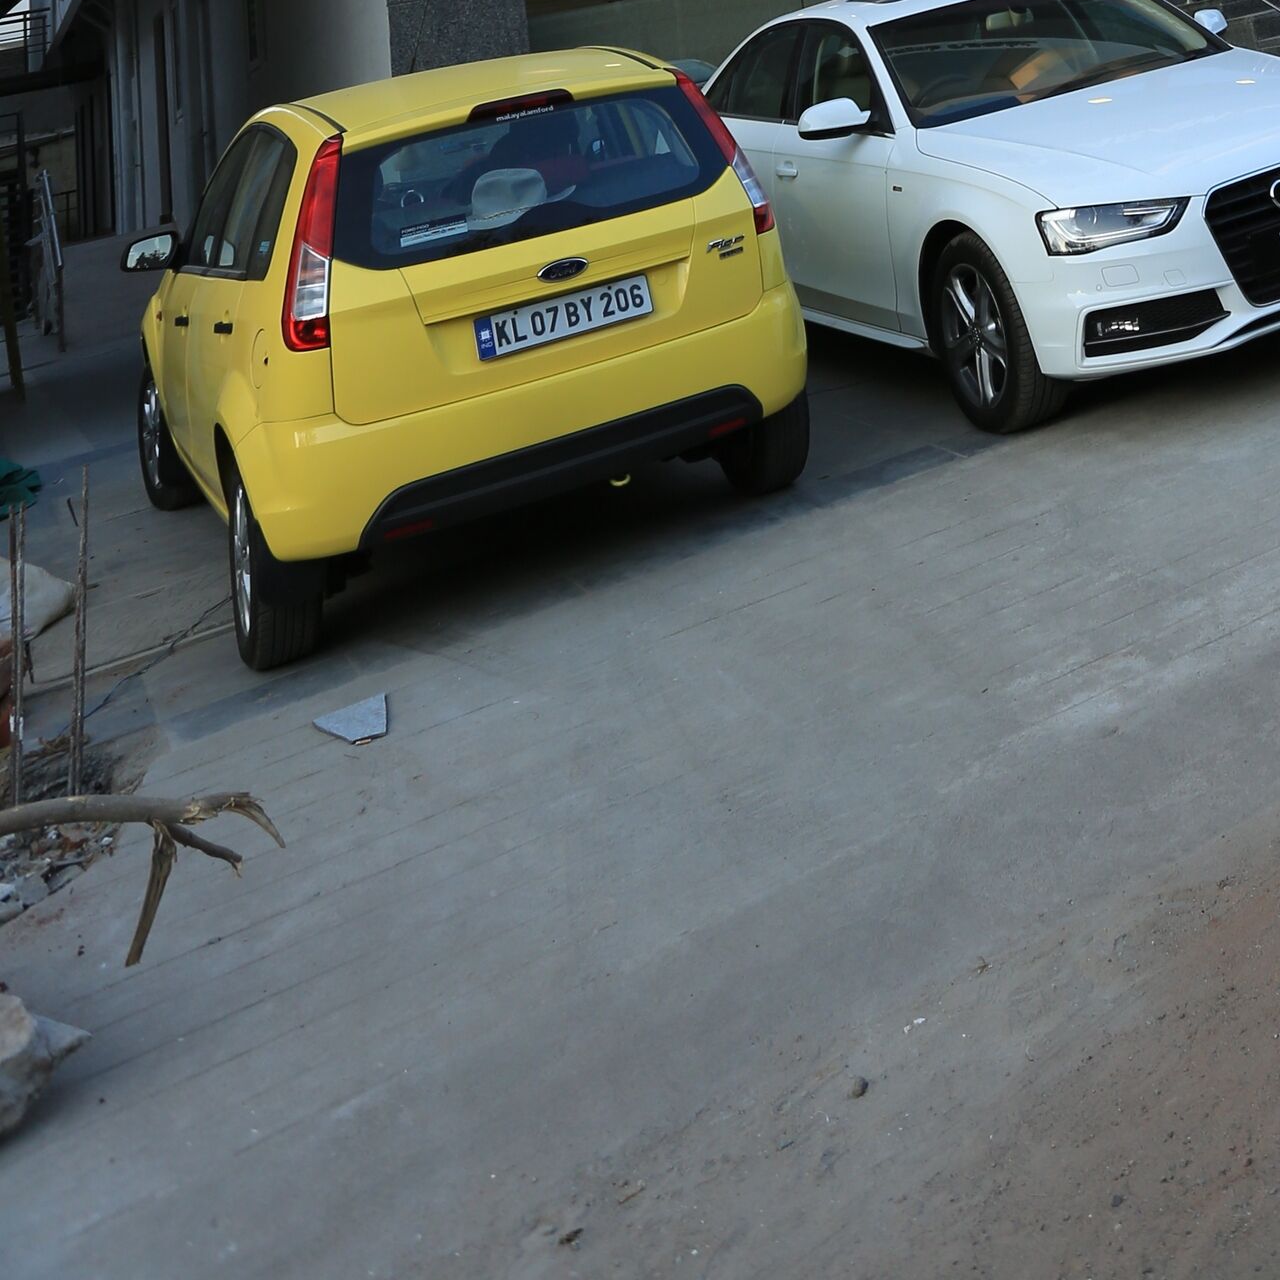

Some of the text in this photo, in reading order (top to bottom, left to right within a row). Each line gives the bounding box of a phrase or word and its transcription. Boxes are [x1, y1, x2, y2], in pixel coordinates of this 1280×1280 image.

[495, 284, 645, 347] KL 07 BY 206
